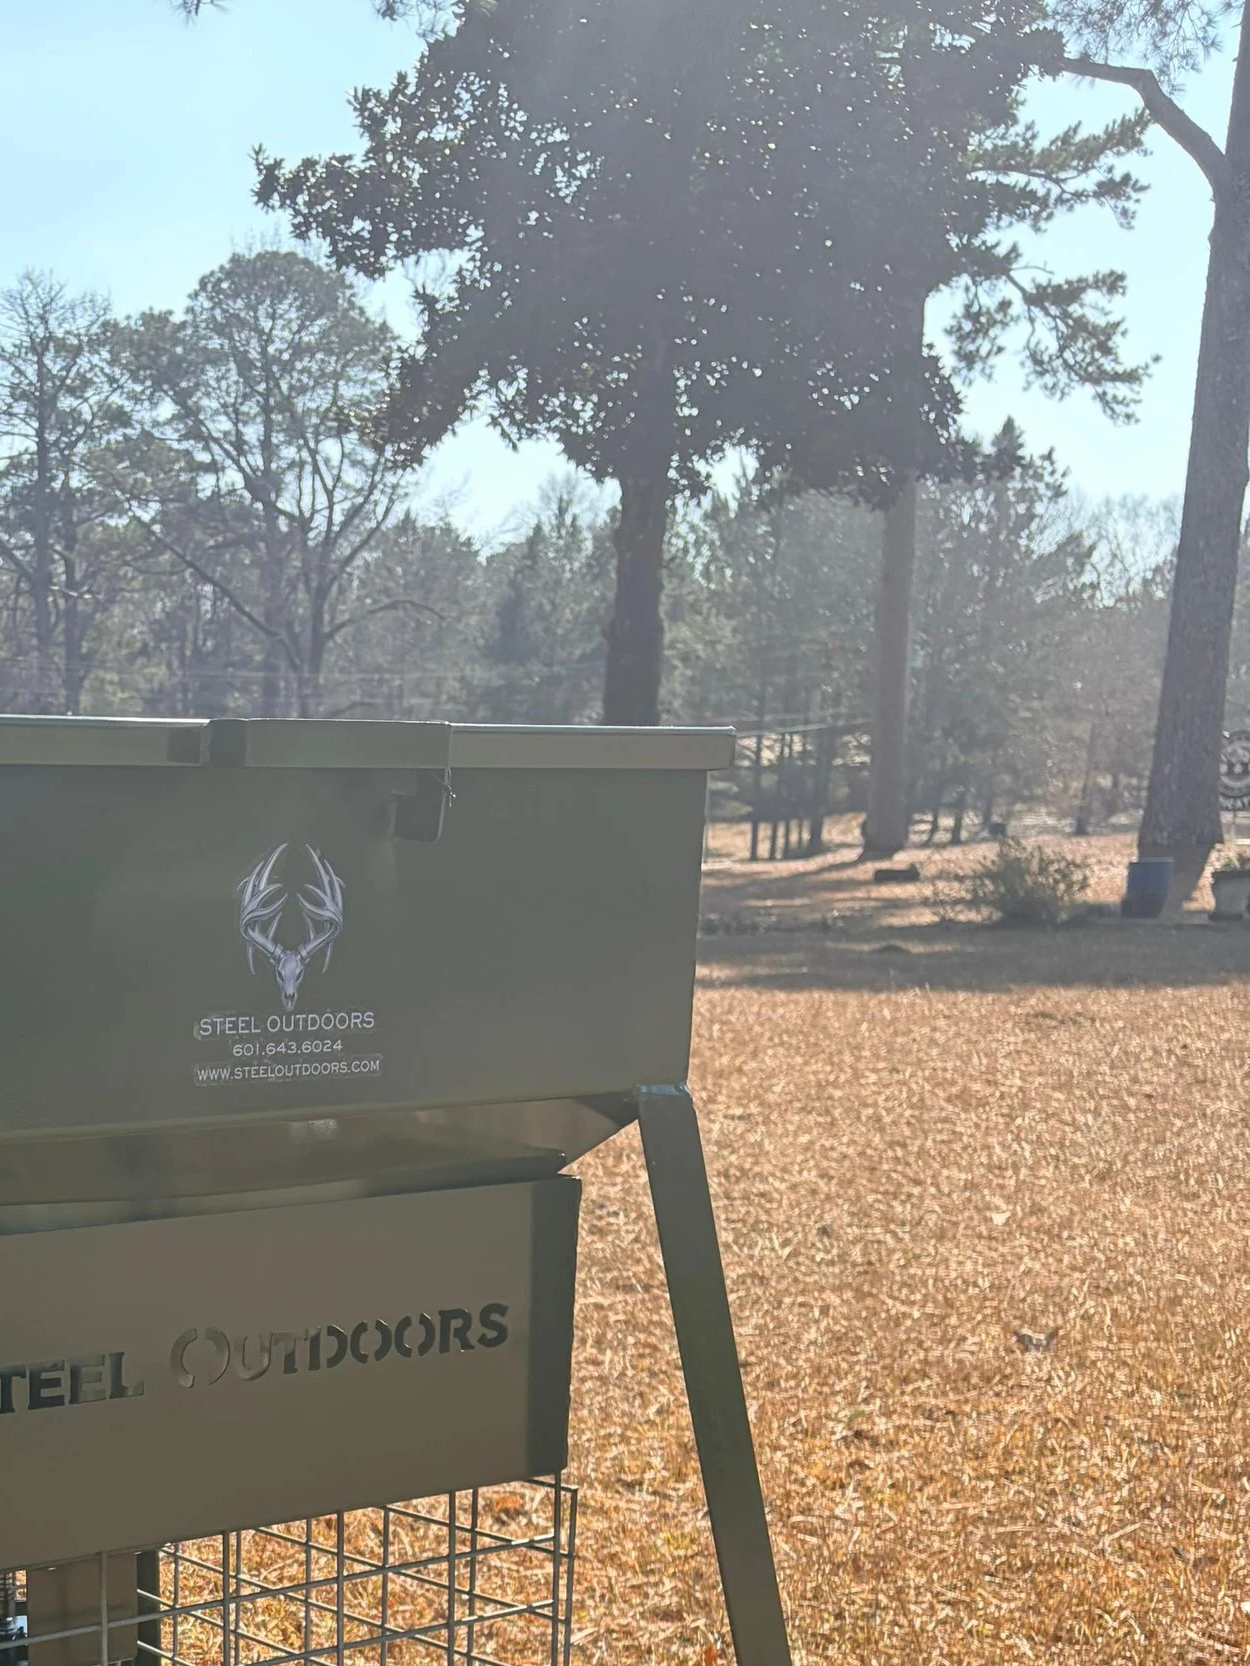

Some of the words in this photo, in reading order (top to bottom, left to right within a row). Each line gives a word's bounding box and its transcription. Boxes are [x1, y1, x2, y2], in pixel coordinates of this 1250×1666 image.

[199, 1016, 261, 1036] STEEL
[266, 1011, 375, 1032] OUTDOORS
[232, 1040, 343, 1057] 601.643.6024
[197, 1060, 380, 1081] WWW.STEELOUTDOORS.COM
[168, 1302, 510, 1389] OUTDOORS
